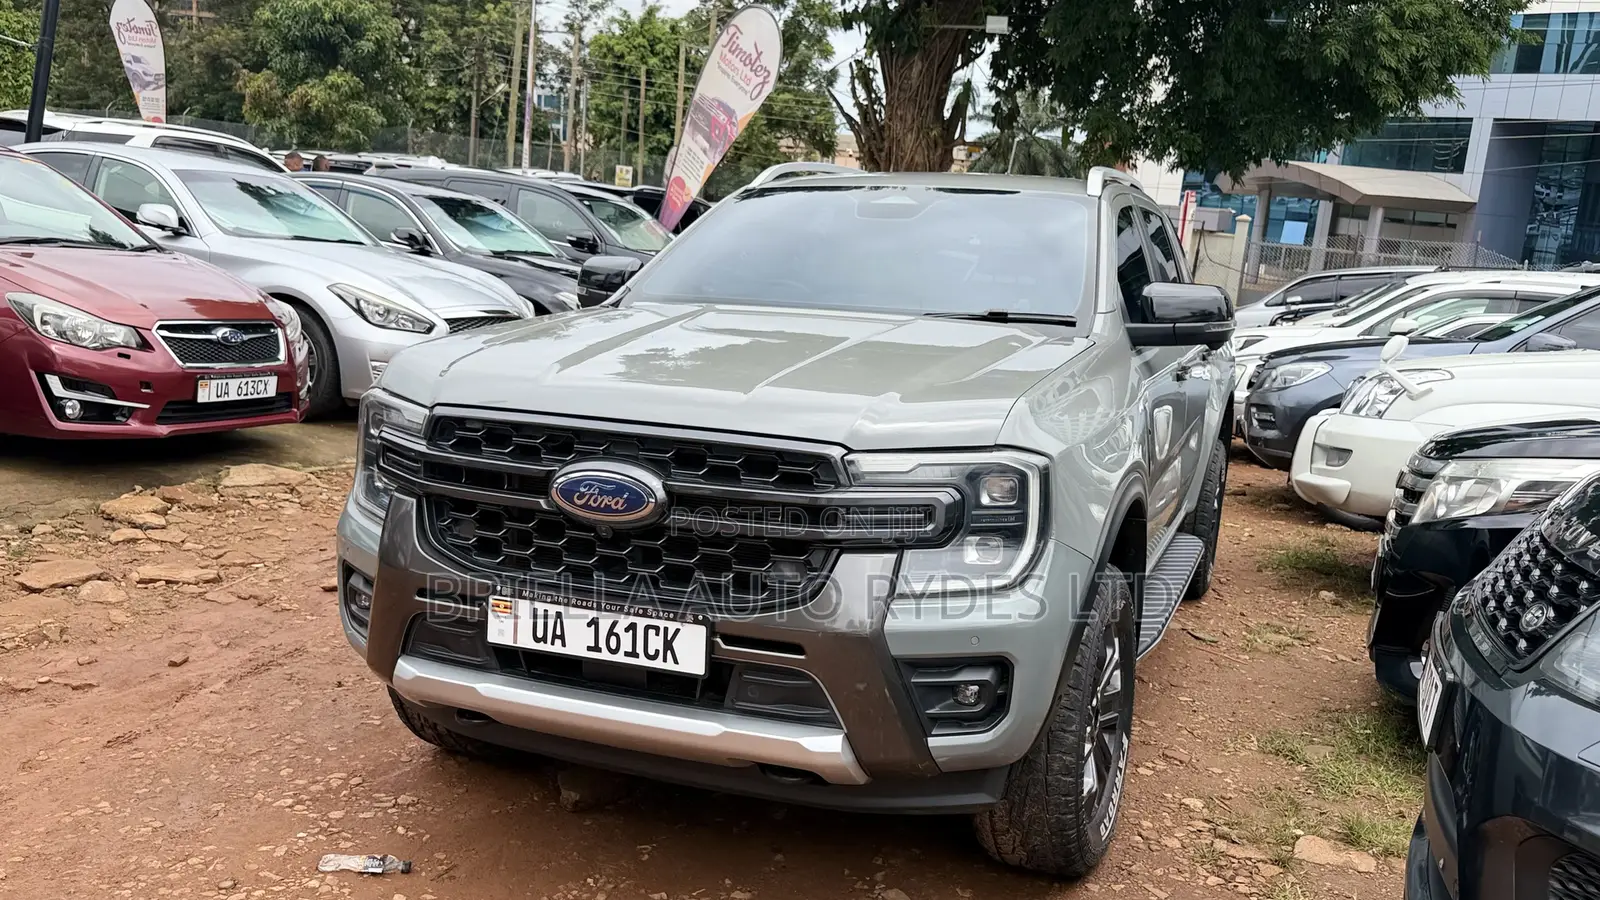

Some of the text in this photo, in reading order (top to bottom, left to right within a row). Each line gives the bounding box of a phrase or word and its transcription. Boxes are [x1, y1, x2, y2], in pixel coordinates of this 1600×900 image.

[721, 23, 771, 101] Timotez
[216, 379, 270, 398] UA 613CX
[573, 480, 630, 510] Ford
[521, 590, 675, 620] Making the Roads Your Safe Space
[532, 607, 682, 665] UA 161CK
